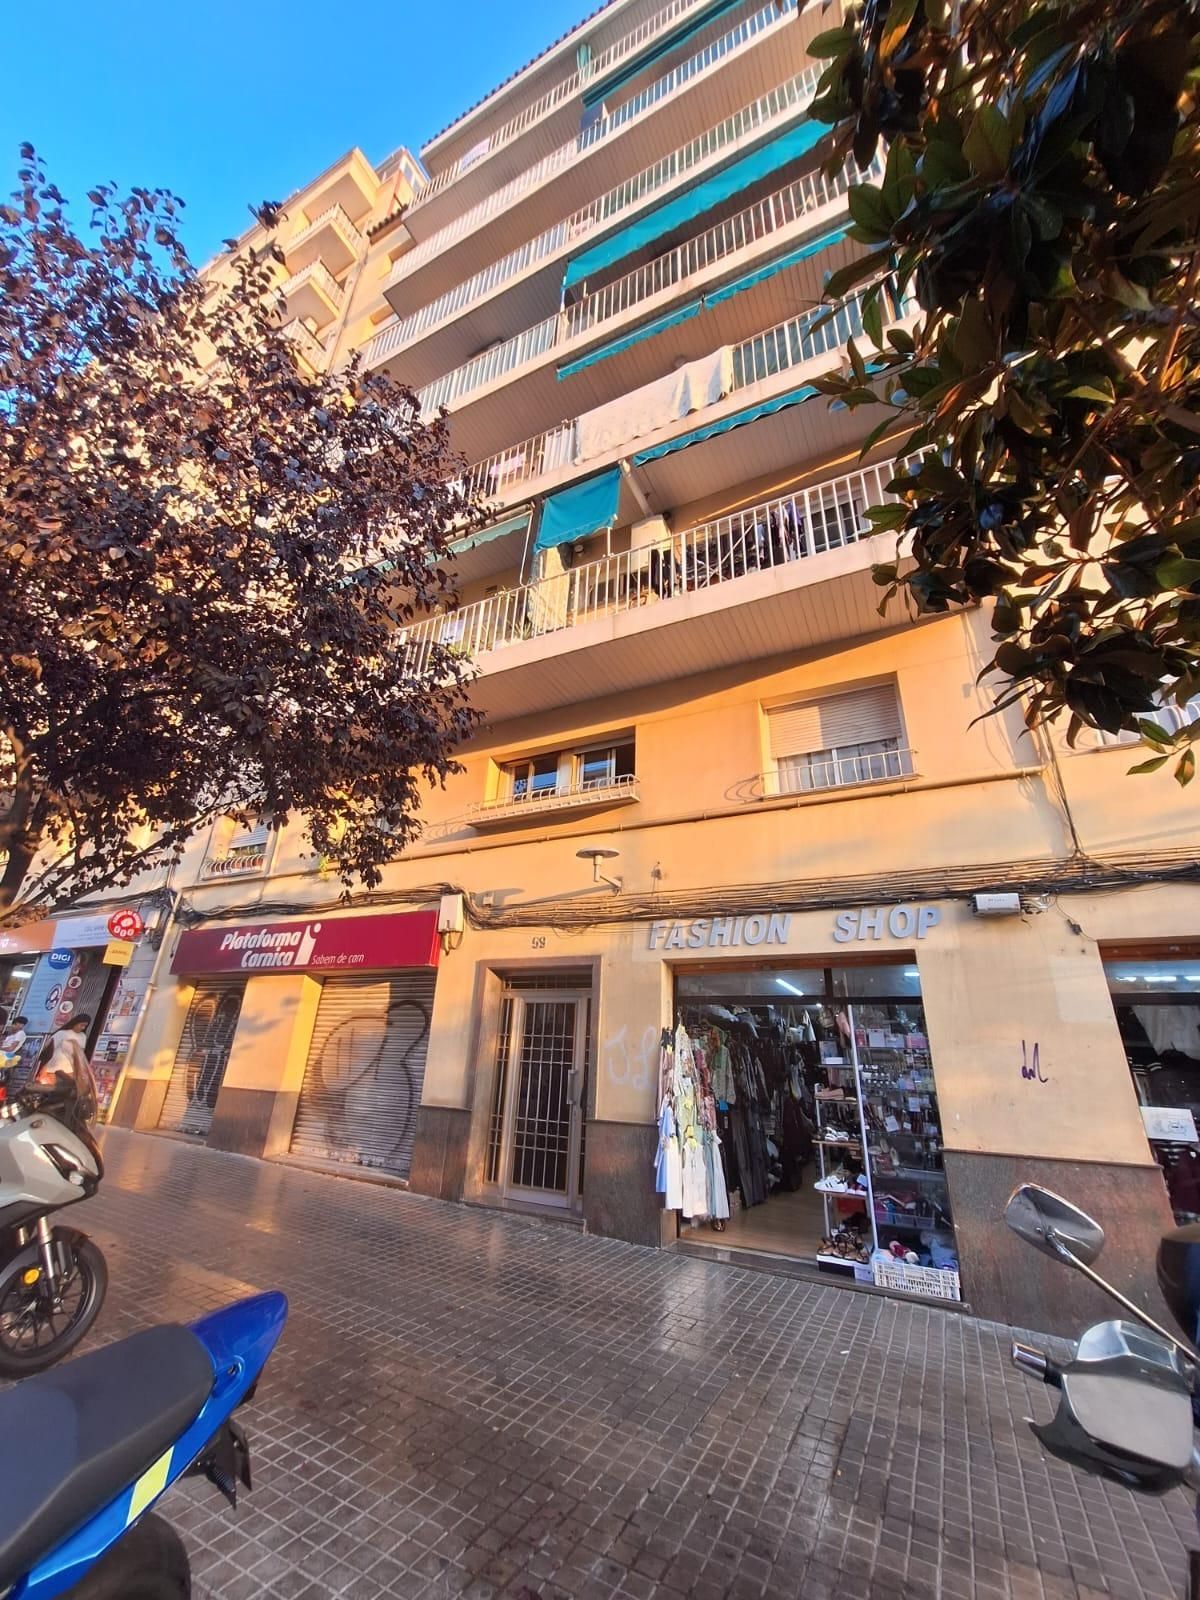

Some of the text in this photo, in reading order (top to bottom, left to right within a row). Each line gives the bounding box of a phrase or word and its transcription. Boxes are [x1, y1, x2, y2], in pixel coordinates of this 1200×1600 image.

[649, 905, 941, 949] FASHION SHOP
[220, 928, 302, 950] Plataforma
[531, 936, 546, 949] 59
[51, 953, 71, 961] DIGI
[241, 946, 295, 968] Carnica
